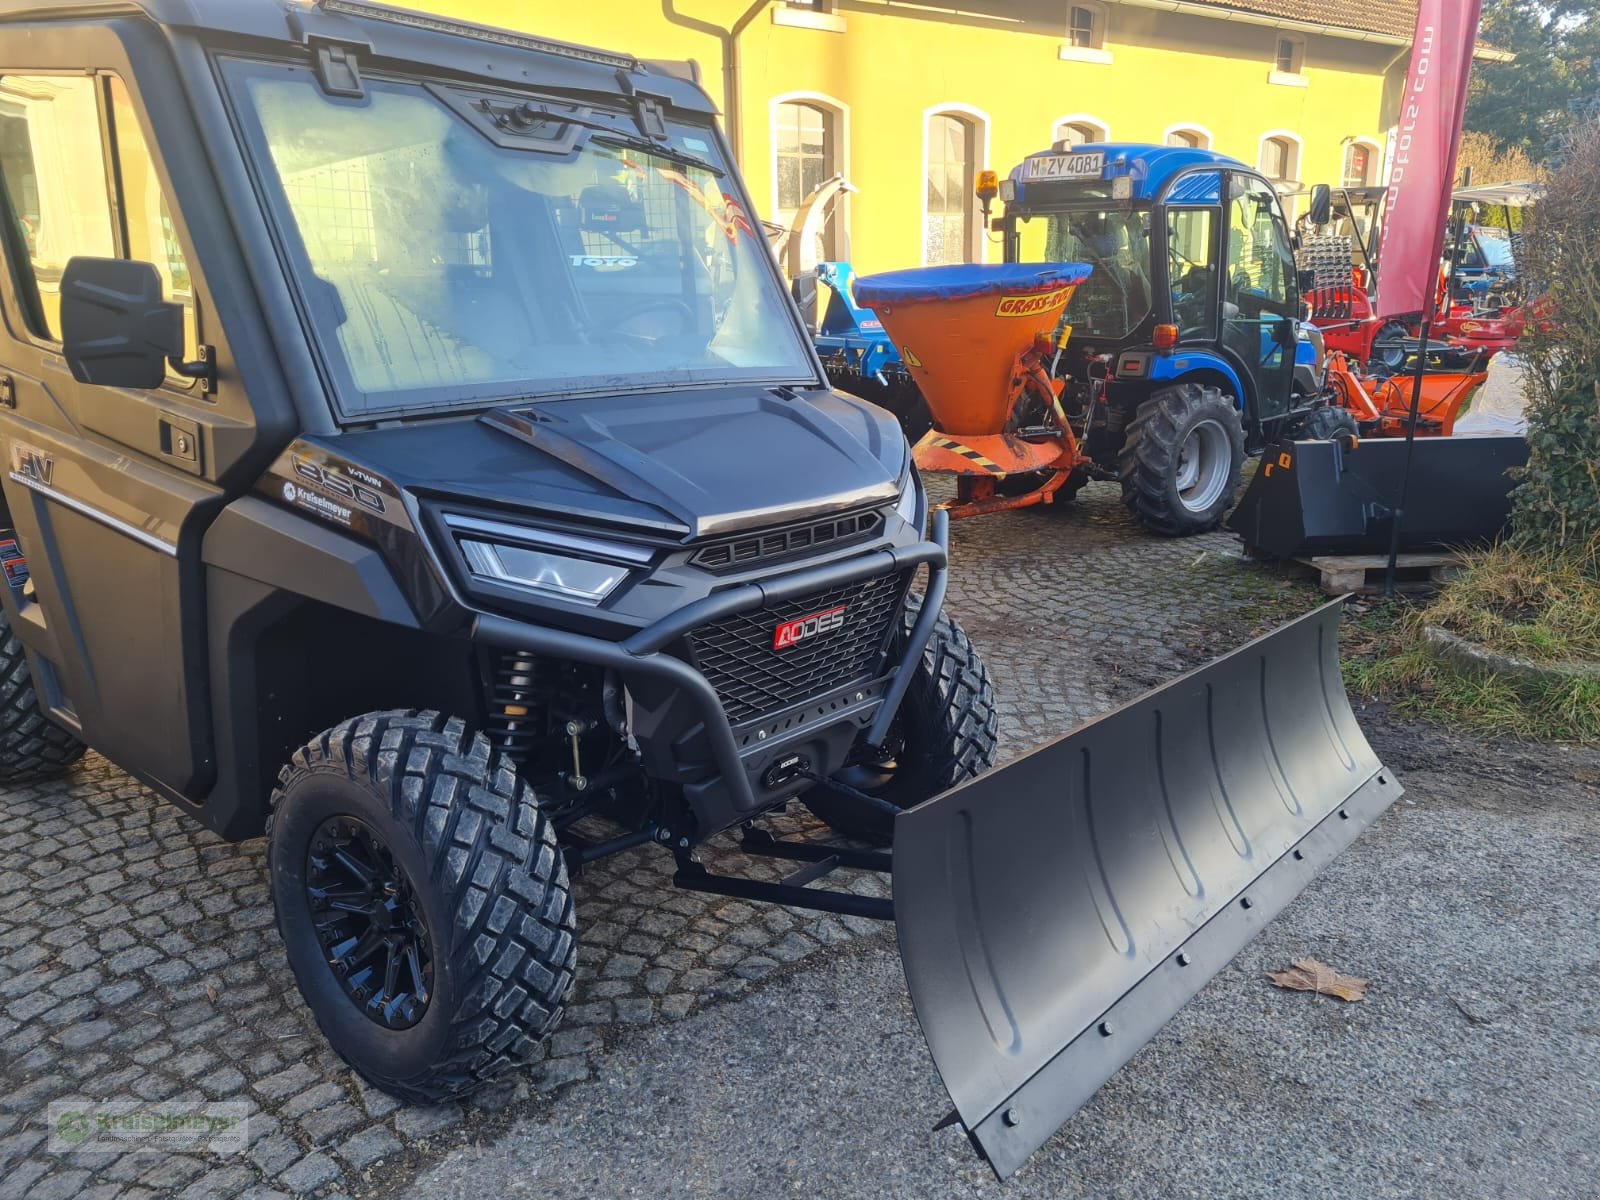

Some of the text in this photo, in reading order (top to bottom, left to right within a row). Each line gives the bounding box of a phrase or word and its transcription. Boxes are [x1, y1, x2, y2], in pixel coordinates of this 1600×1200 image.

[1031, 155, 1100, 176] M ZY 4081
[347, 466, 382, 488] V-TWIN
[297, 487, 352, 519] Kreiselmeyer
[777, 608, 845, 647] AODES
